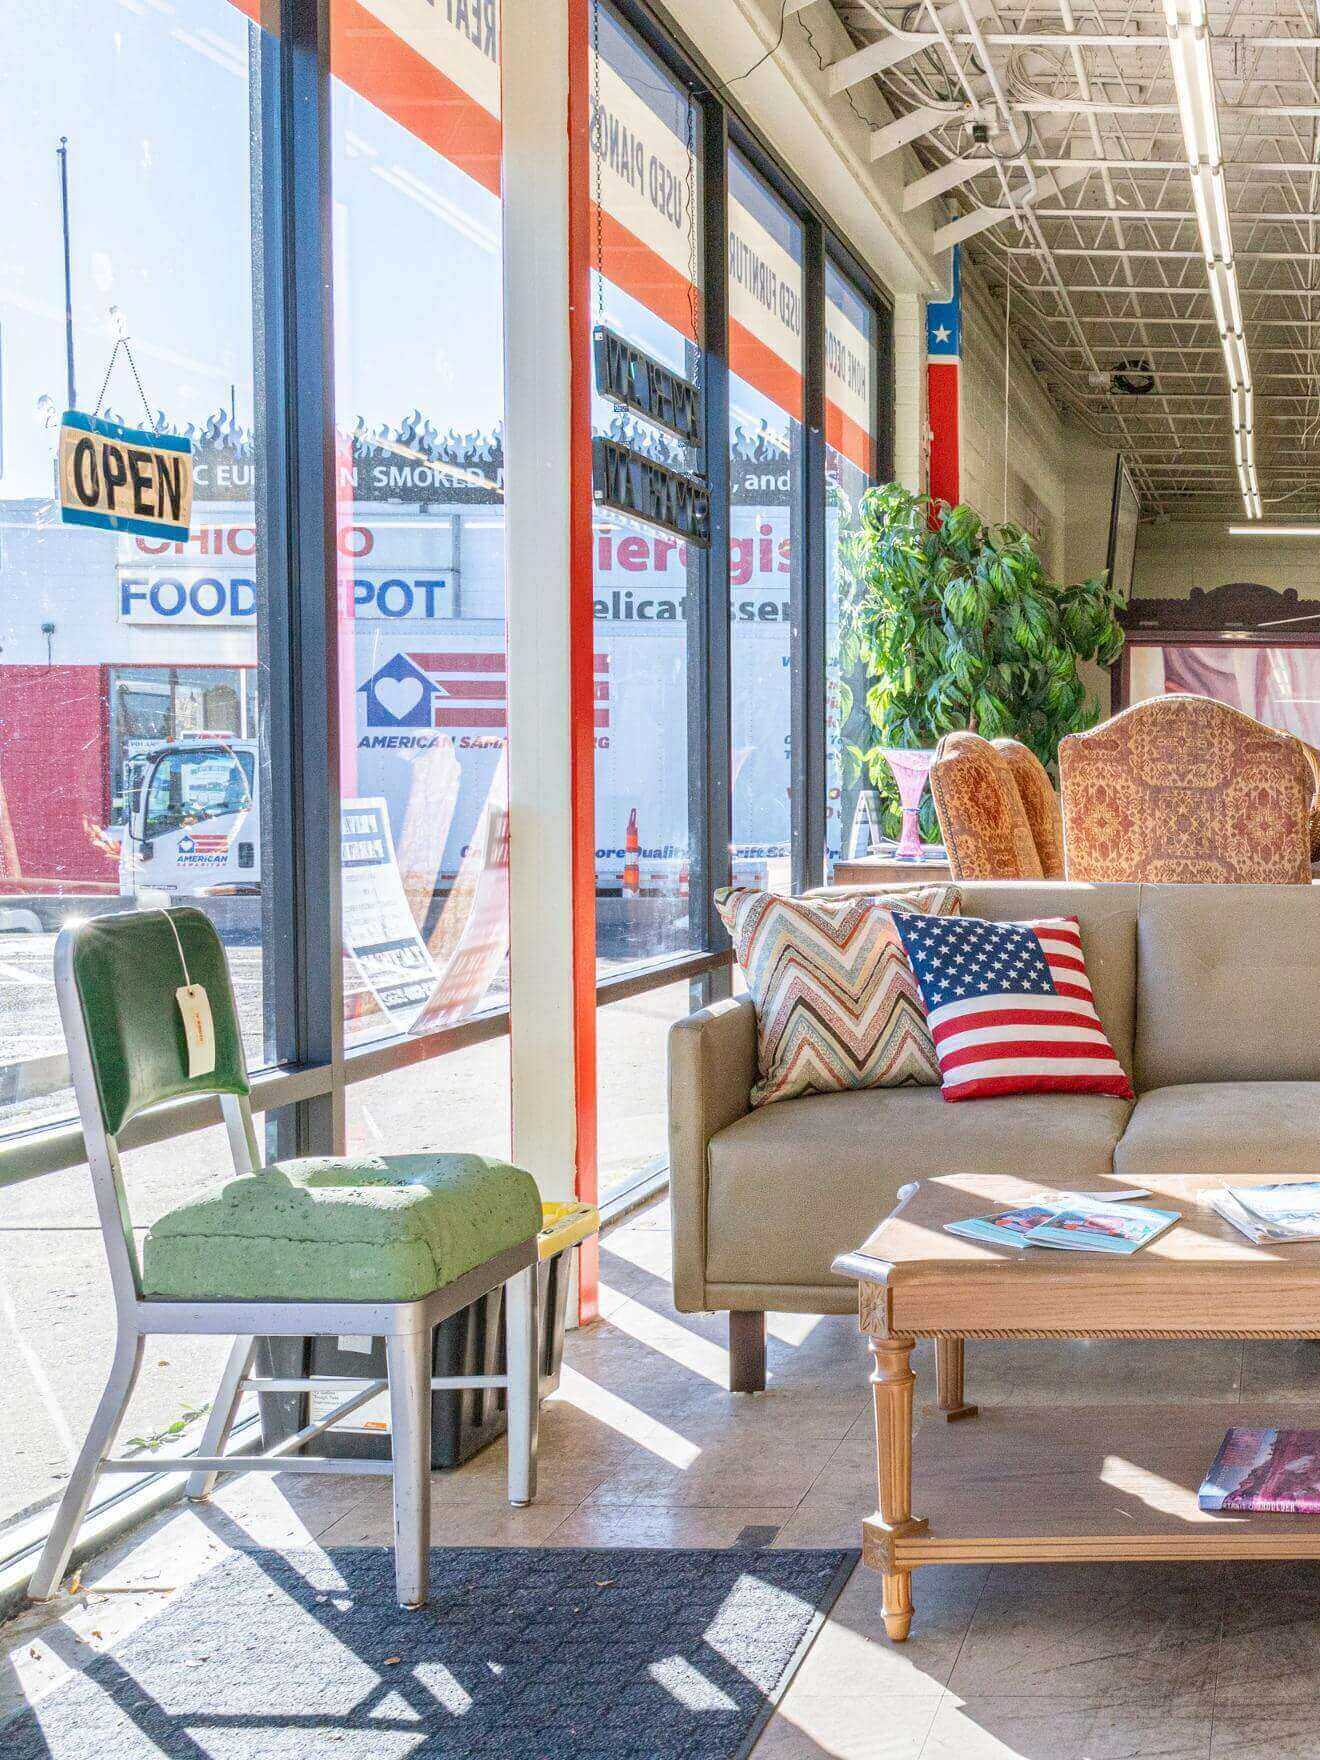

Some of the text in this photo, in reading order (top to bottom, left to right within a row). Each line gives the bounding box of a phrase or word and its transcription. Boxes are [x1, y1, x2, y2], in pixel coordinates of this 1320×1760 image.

[73, 437, 181, 521] OPEN
[373, 465, 485, 488] SMOKED
[121, 577, 446, 618] FOOD POT
[176, 855, 229, 863] AMERICAN
